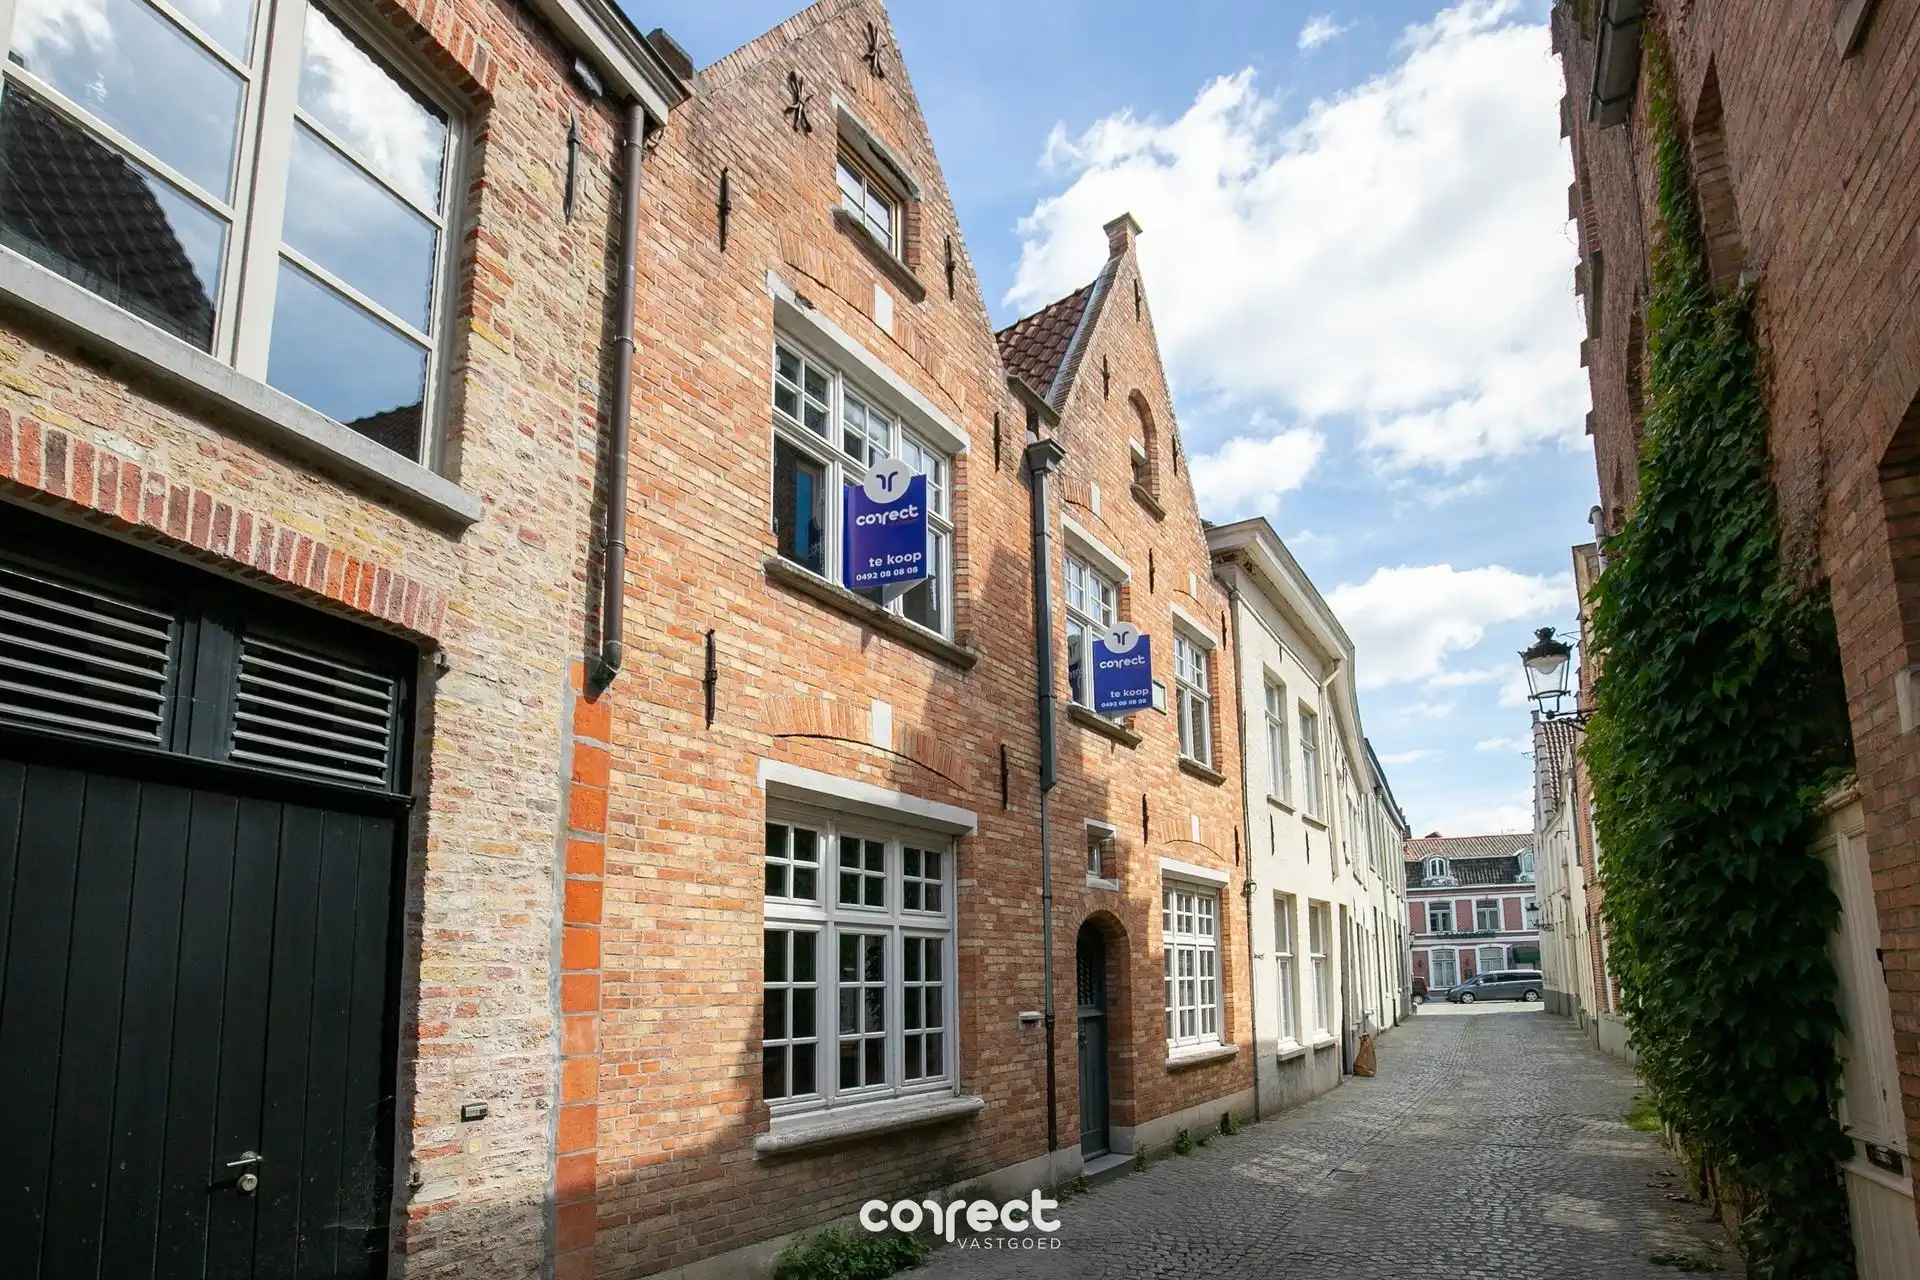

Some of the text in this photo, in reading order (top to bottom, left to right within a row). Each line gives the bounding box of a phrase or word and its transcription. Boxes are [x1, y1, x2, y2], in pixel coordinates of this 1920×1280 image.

[856, 504, 919, 526] correct
[869, 552, 922, 567] te koop
[856, 573, 878, 581] 0492
[1100, 655, 1146, 669] correct
